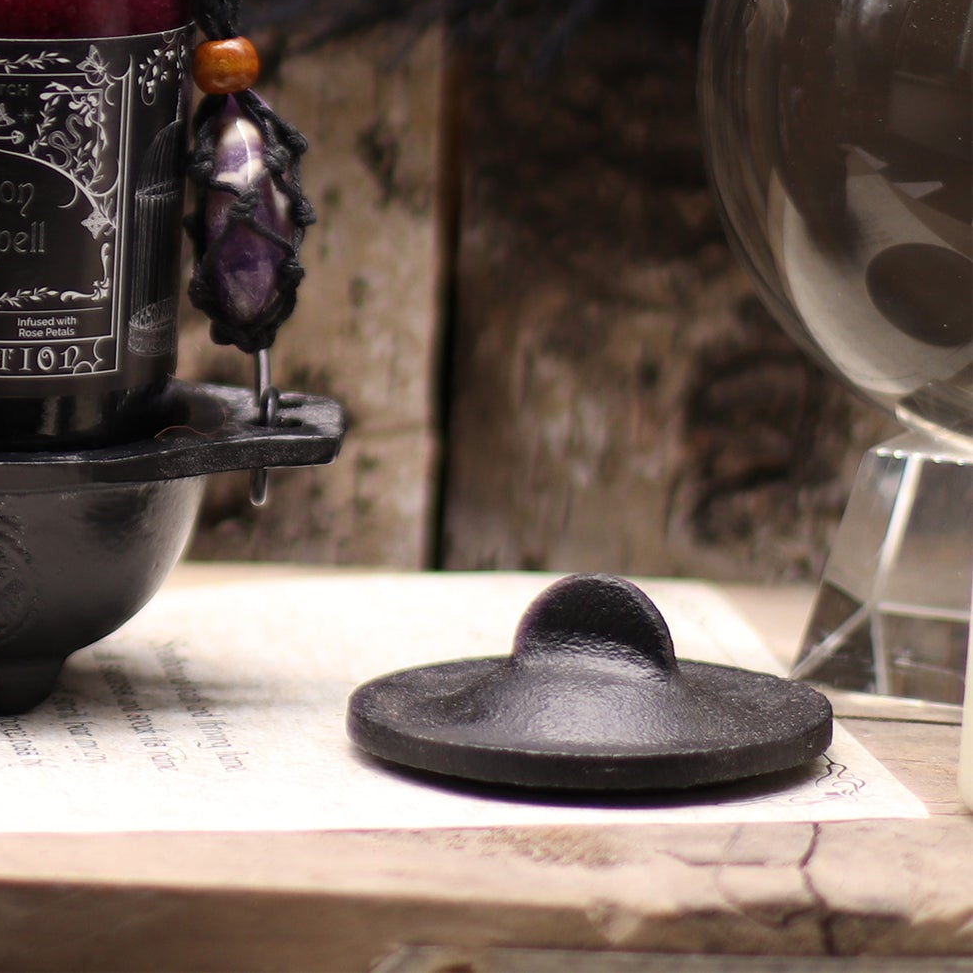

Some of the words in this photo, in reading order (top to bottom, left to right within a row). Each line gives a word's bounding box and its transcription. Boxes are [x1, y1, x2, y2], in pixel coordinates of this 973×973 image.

[17, 316, 55, 327] Infused
[55, 315, 77, 326] with
[18, 328, 44, 338] Rose
[45, 327, 75, 337] Petals
